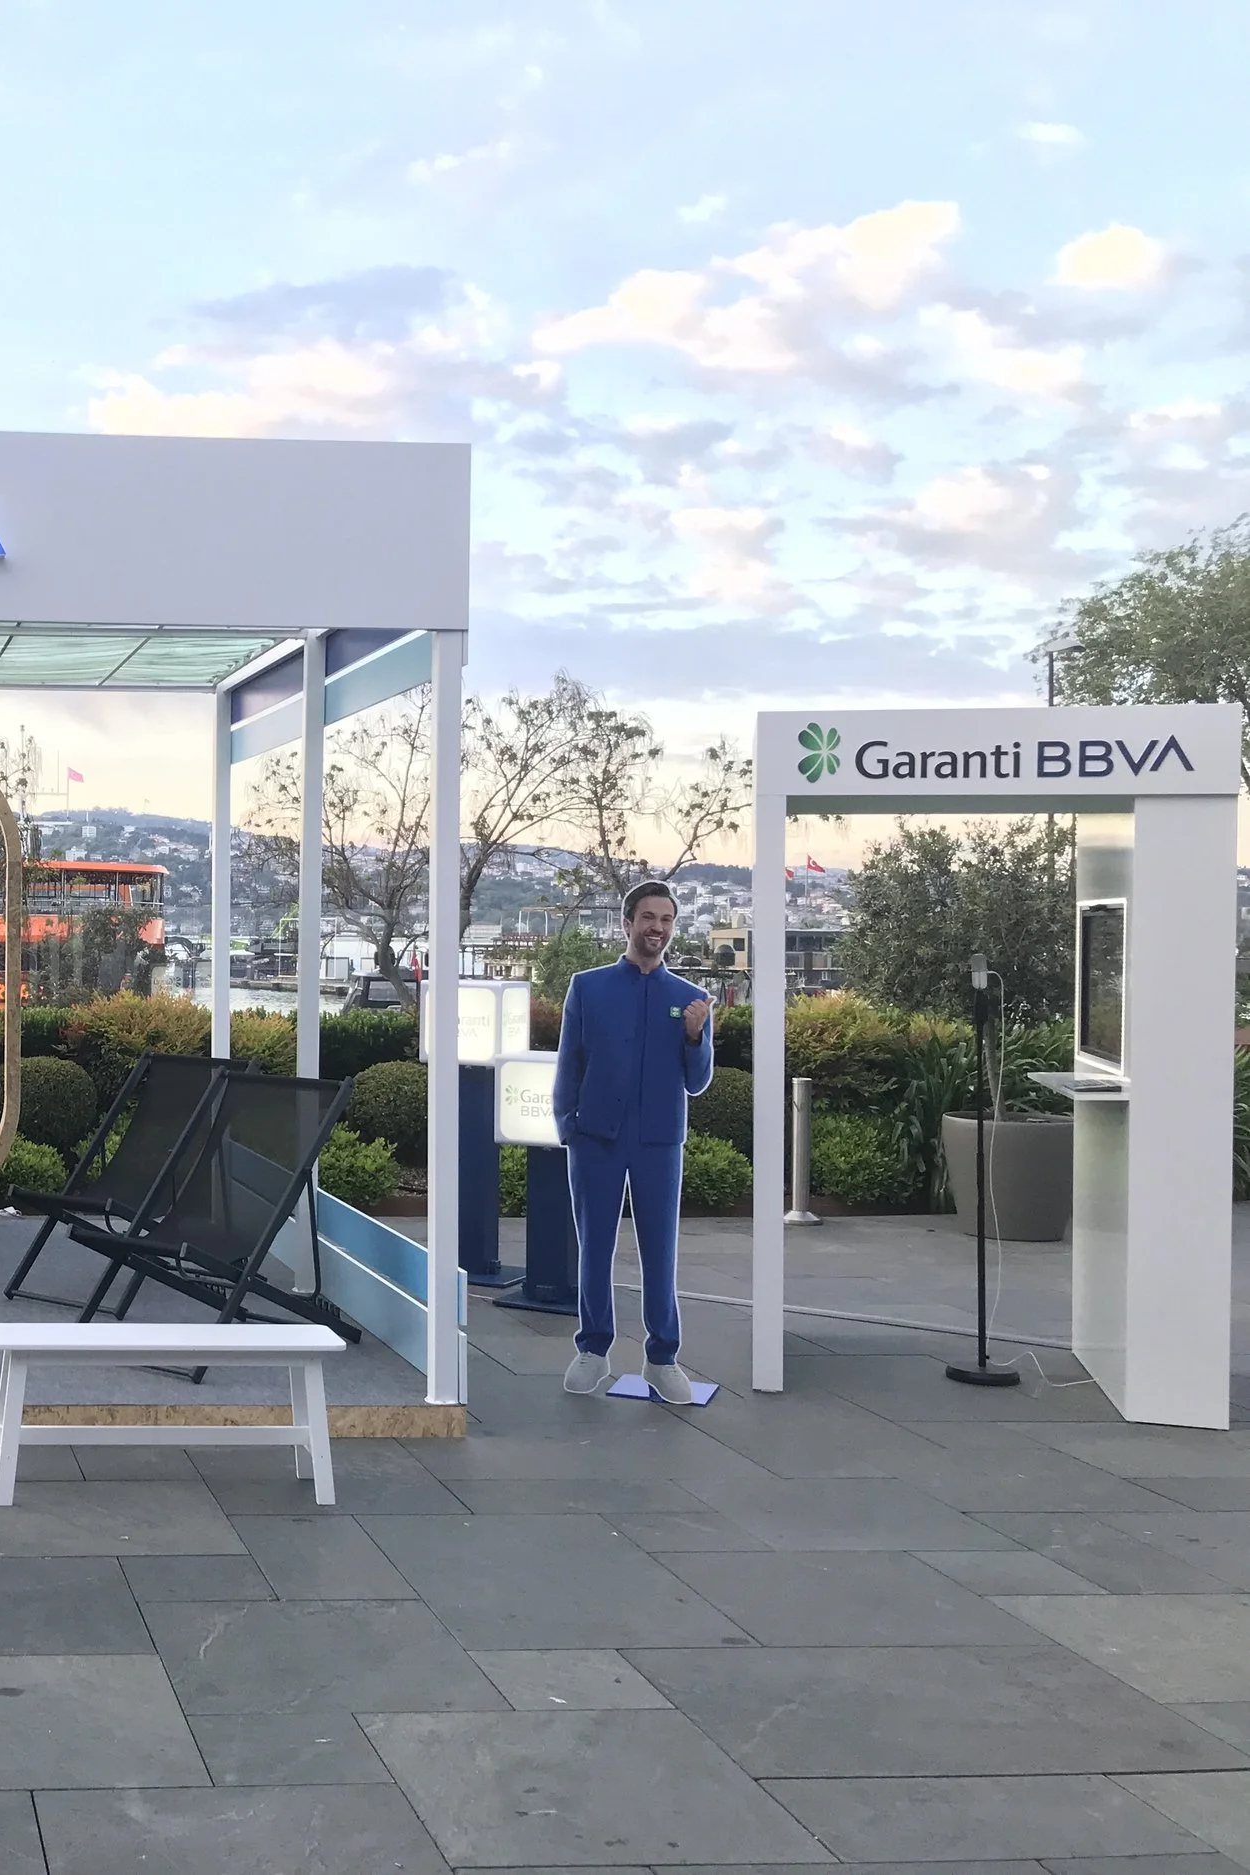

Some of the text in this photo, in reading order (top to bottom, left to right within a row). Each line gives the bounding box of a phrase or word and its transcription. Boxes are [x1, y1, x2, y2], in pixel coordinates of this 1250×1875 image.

[854, 734, 1194, 779] Garanti BBVA
[457, 1015, 491, 1027] ranti
[520, 1089, 553, 1105] Gara
